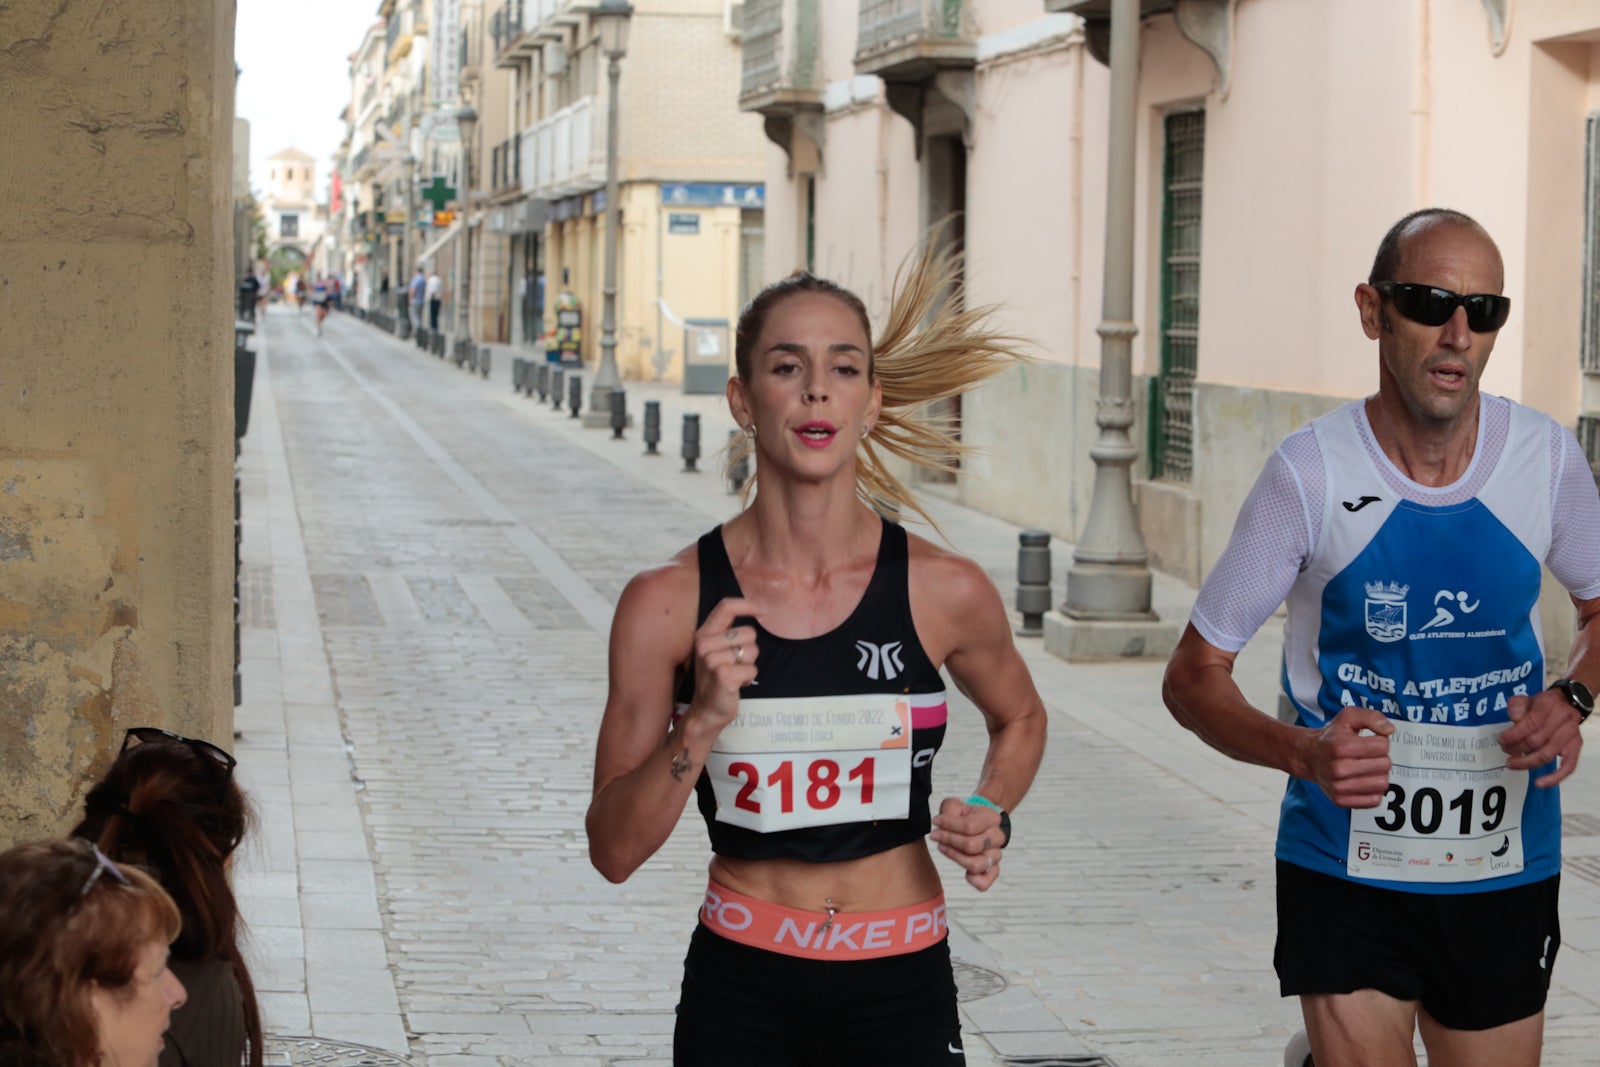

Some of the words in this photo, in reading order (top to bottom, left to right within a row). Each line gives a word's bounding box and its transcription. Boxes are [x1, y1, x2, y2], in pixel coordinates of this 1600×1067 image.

[1338, 662, 1396, 694] CLUB
[1402, 660, 1532, 699] ATLETISMO
[858, 709, 884, 725] 2022
[727, 757, 876, 814] 2181
[1374, 784, 1508, 836] 3019
[773, 917, 897, 951] NIKE
